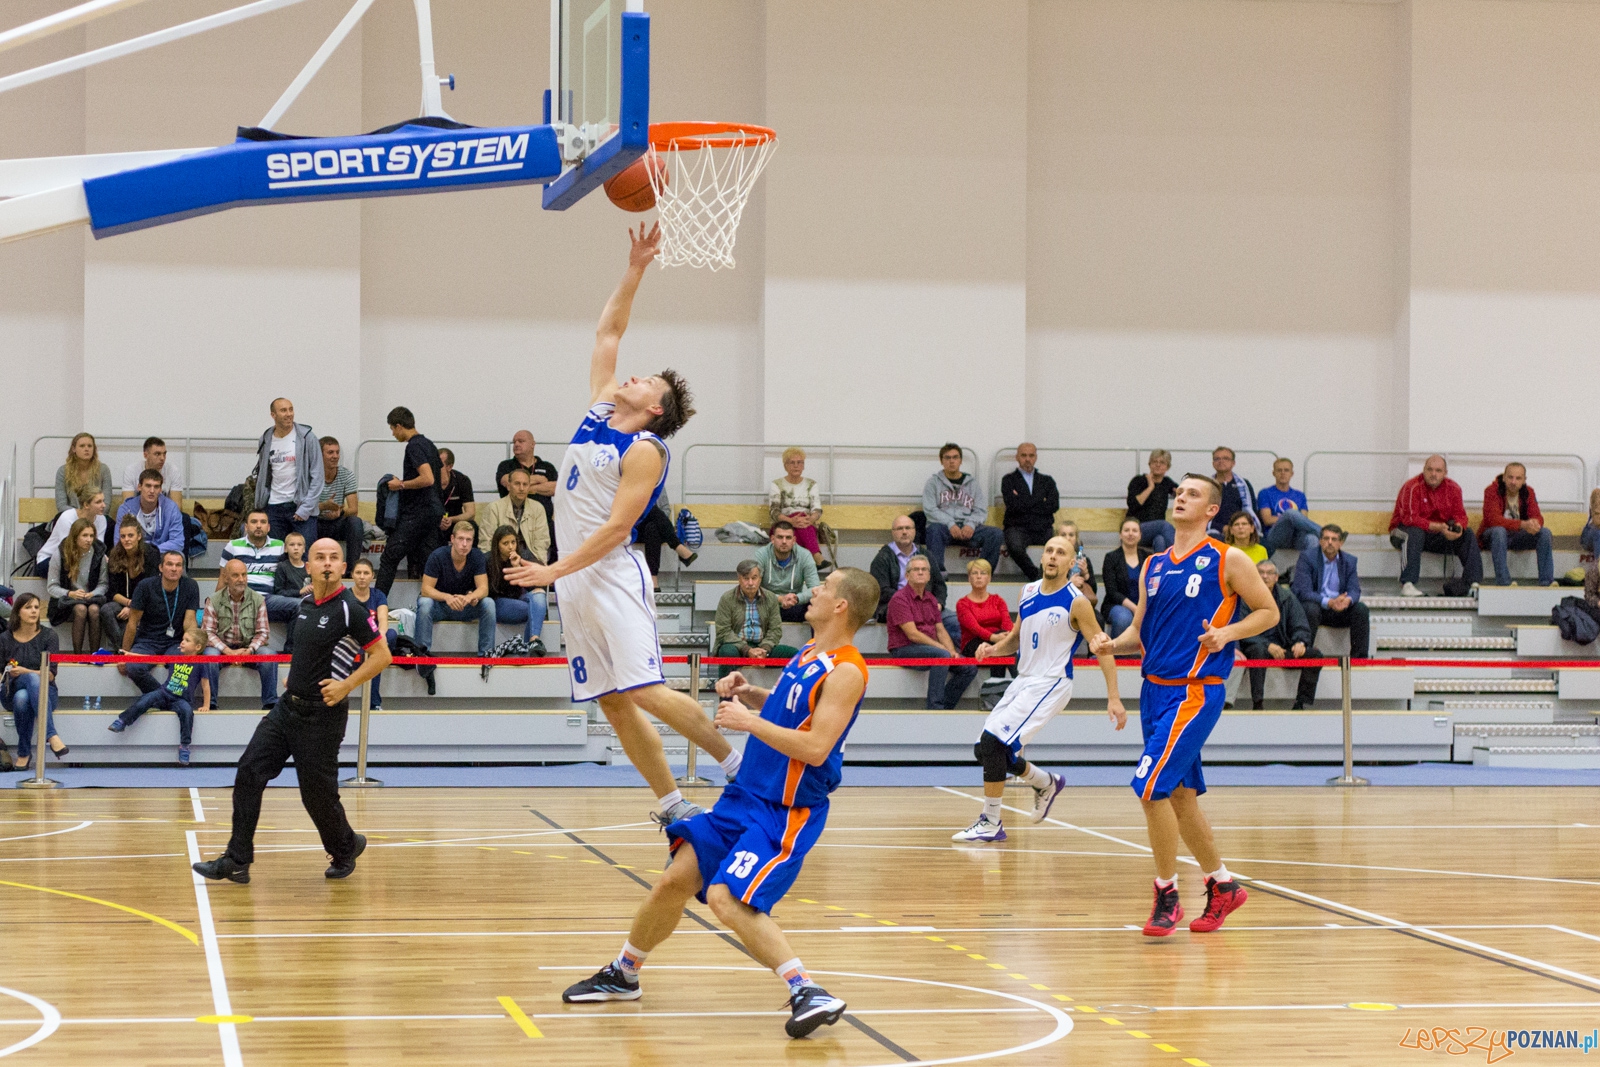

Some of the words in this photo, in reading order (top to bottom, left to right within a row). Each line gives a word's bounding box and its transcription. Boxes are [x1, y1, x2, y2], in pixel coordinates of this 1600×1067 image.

[566, 464, 580, 491] 8
[1185, 573, 1203, 598] 8
[1032, 632, 1039, 650] 9
[571, 655, 588, 684] 8
[1135, 755, 1153, 779] 8
[726, 850, 759, 879] 13
